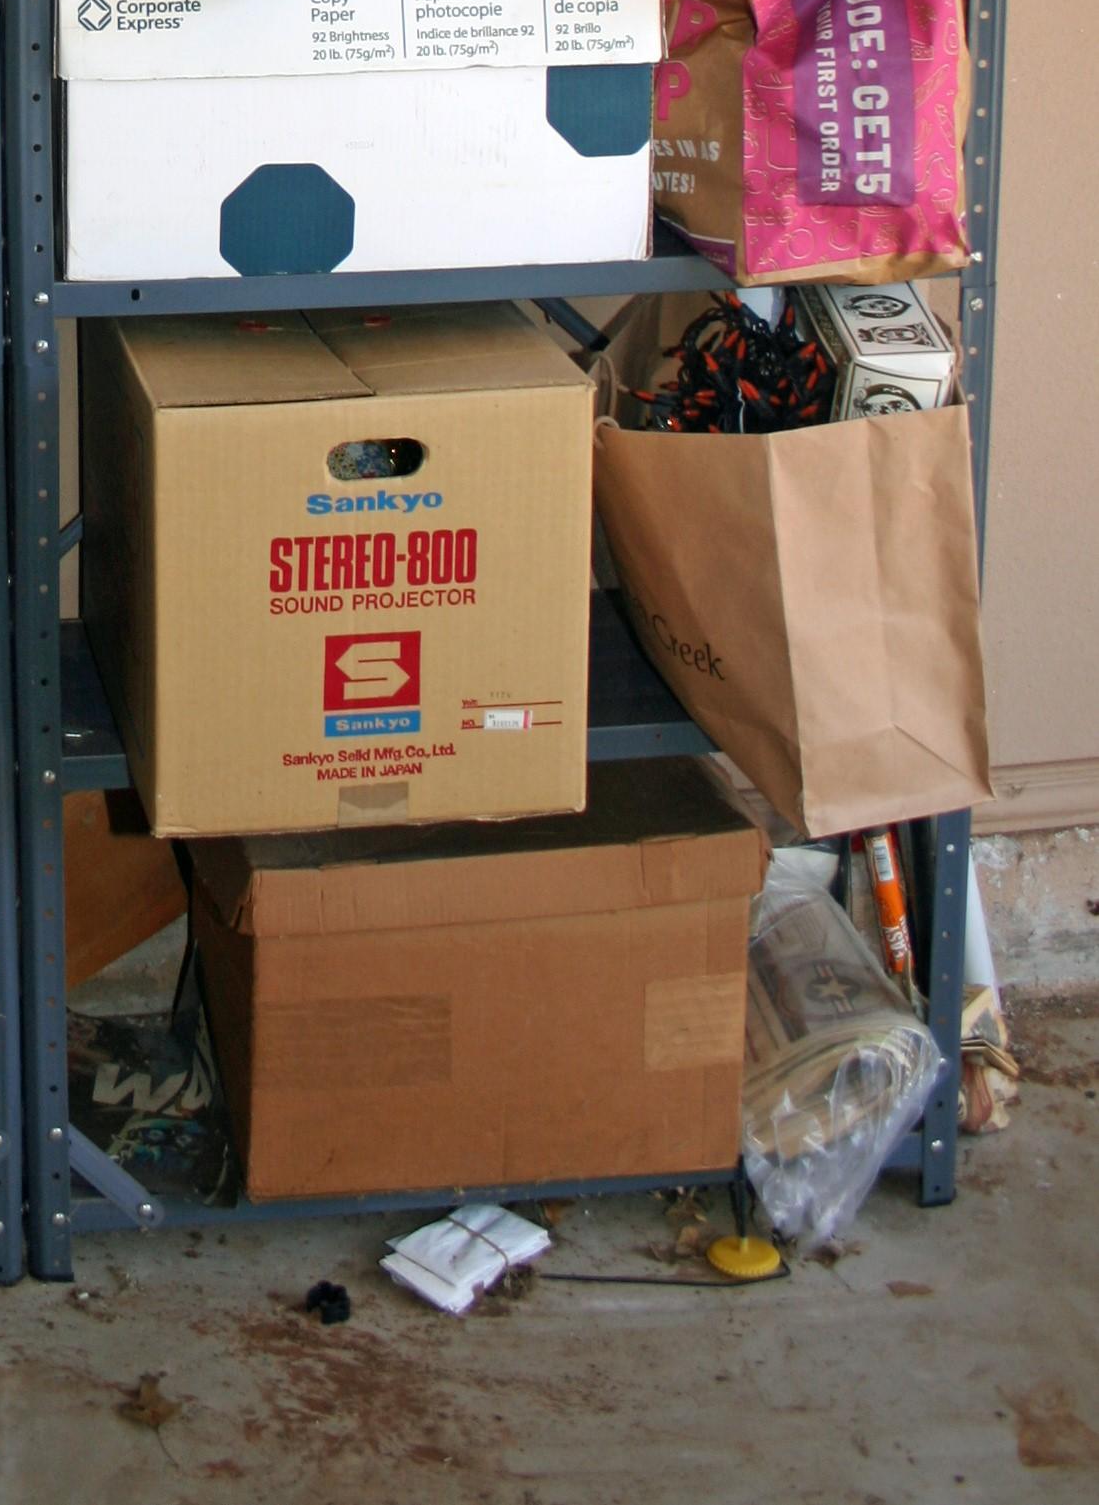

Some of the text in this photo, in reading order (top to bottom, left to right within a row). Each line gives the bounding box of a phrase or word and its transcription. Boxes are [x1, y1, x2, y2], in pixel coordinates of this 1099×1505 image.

[311, 7, 355, 24] Paper
[416, 3, 503, 22] photocopie
[554, 0, 574, 14] de
[117, 15, 182, 34] Express
[555, 23, 602, 35] 92 Brillo
[815, 2, 833, 41] YOUR
[312, 31, 390, 45] 92 Brightness
[417, 25, 535, 39] Indice de brillance 92
[313, 50, 327, 60] 20
[329, 49, 343, 60] lb.
[417, 46, 431, 57] 20
[433, 45, 447, 57] lb.
[555, 41, 569, 51] 20
[571, 39, 585, 51] lb.
[815, 47, 838, 113] FIRST
[852, 84, 891, 195] GET5
[677, 139, 697, 158] IN
[700, 141, 720, 162] AS
[819, 121, 841, 193] ORDER
[653, 172, 695, 194] UTES!
[306, 490, 443, 515] Sankyo
[269, 528, 478, 593] STEREO-800
[269, 588, 476, 615] SOUND PROJECTOR
[652, 614, 726, 681] Creek
[335, 716, 412, 732] Sankyo
[282, 752, 334, 767] Sankyo
[316, 763, 422, 781] MADE IN JAPAN
